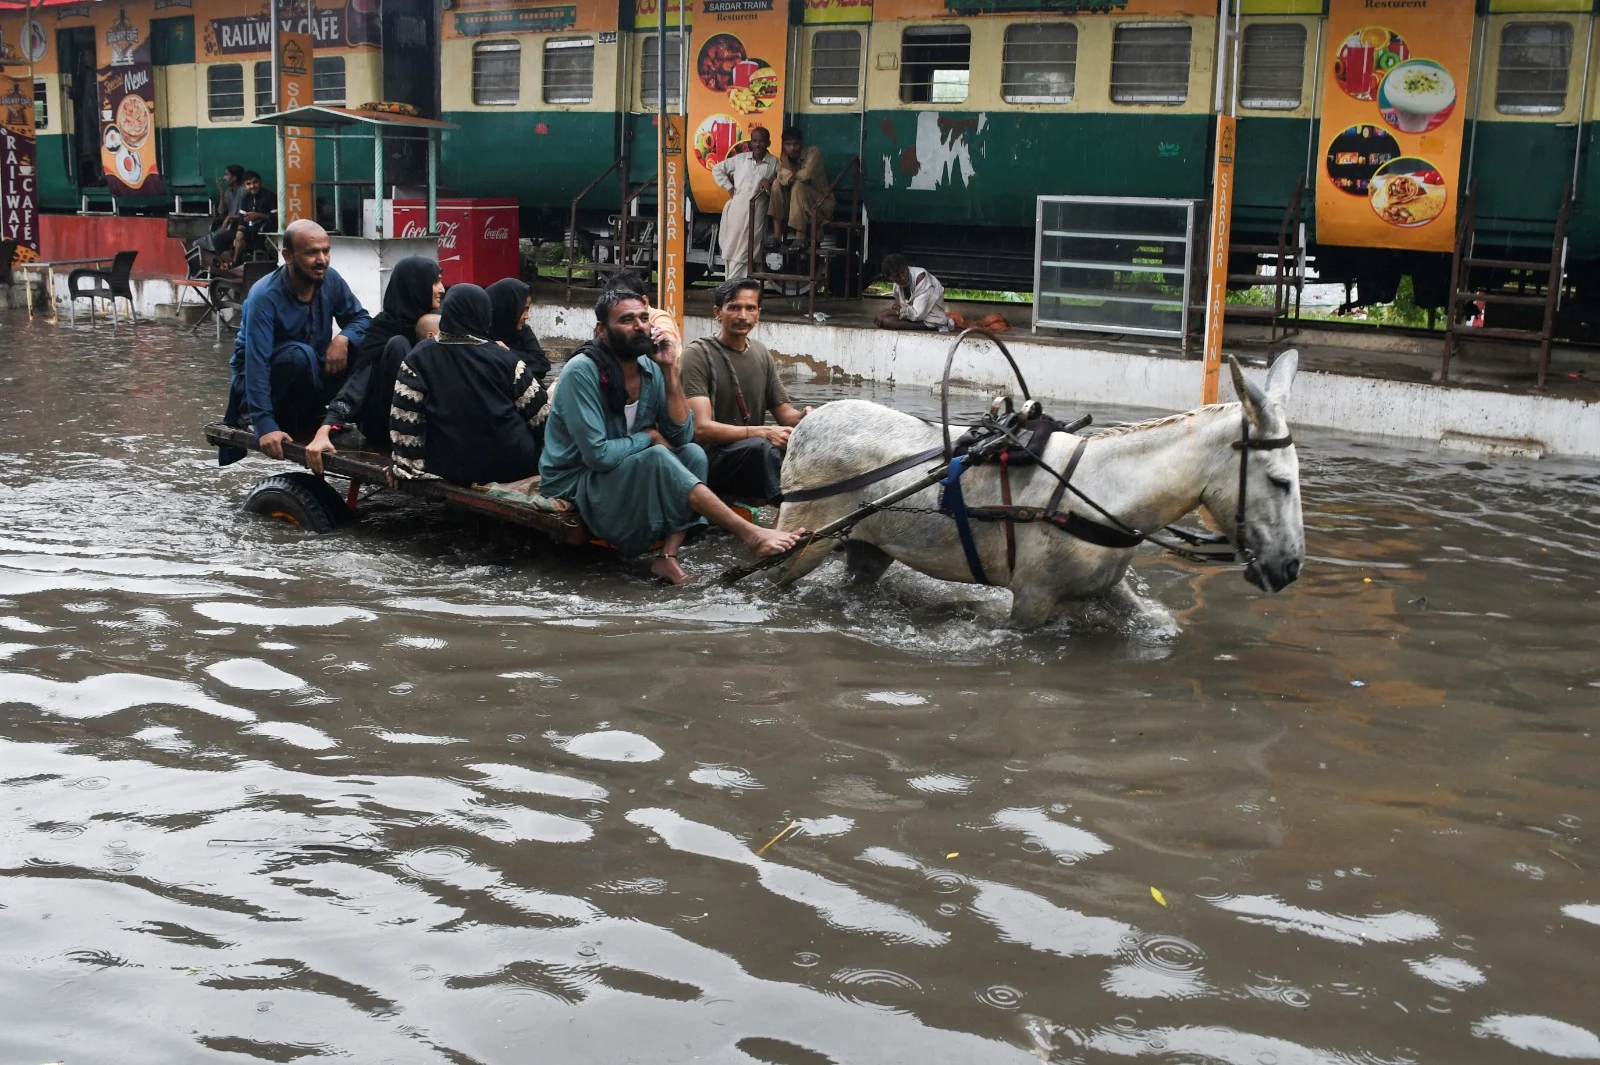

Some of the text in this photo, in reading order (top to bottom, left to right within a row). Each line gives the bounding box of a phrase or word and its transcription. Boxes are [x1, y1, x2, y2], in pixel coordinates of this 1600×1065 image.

[222, 20, 292, 48] RAILWY
[709, 2, 742, 11] SARDAR
[742, 1, 768, 10] TRAIN
[717, 12, 758, 21] Resturent
[1365, 0, 1427, 9] Resturent
[124, 70, 149, 94] Menu
[287, 82, 301, 169] SADAR
[6, 135, 20, 239] RAILWAY
[22, 178, 34, 241] CAFÉ
[289, 183, 301, 226] TRA
[667, 161, 677, 240] SARDAR
[1215, 172, 1227, 267] SARDAR
[667, 253, 677, 319] TRAIN
[1209, 284, 1221, 361] TRAIN
